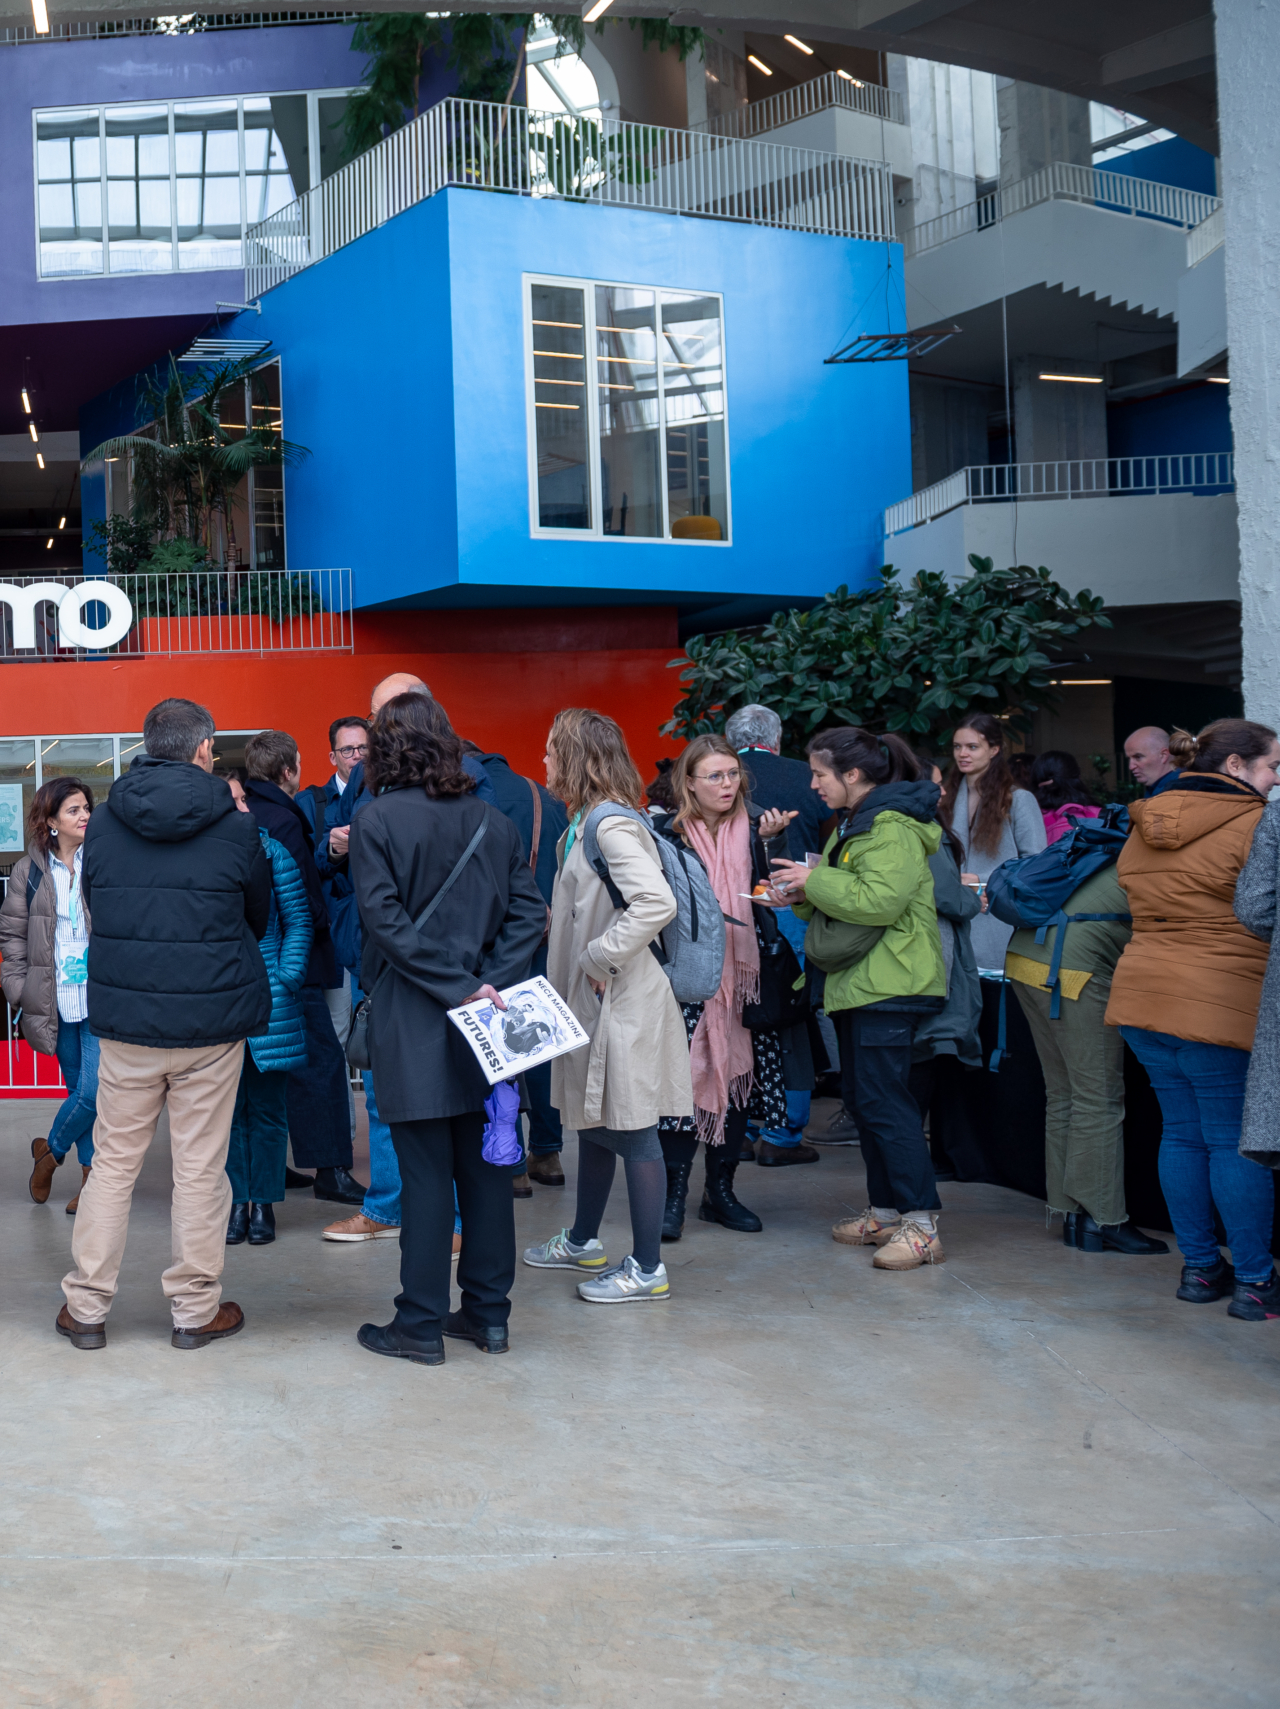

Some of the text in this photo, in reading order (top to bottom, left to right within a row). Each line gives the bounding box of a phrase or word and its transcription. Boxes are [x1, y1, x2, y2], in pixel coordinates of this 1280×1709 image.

[536, 980, 583, 1039] NECE MAGAZINE
[457, 1010, 504, 1074] FUTURES!
[614, 1275, 639, 1293] N
